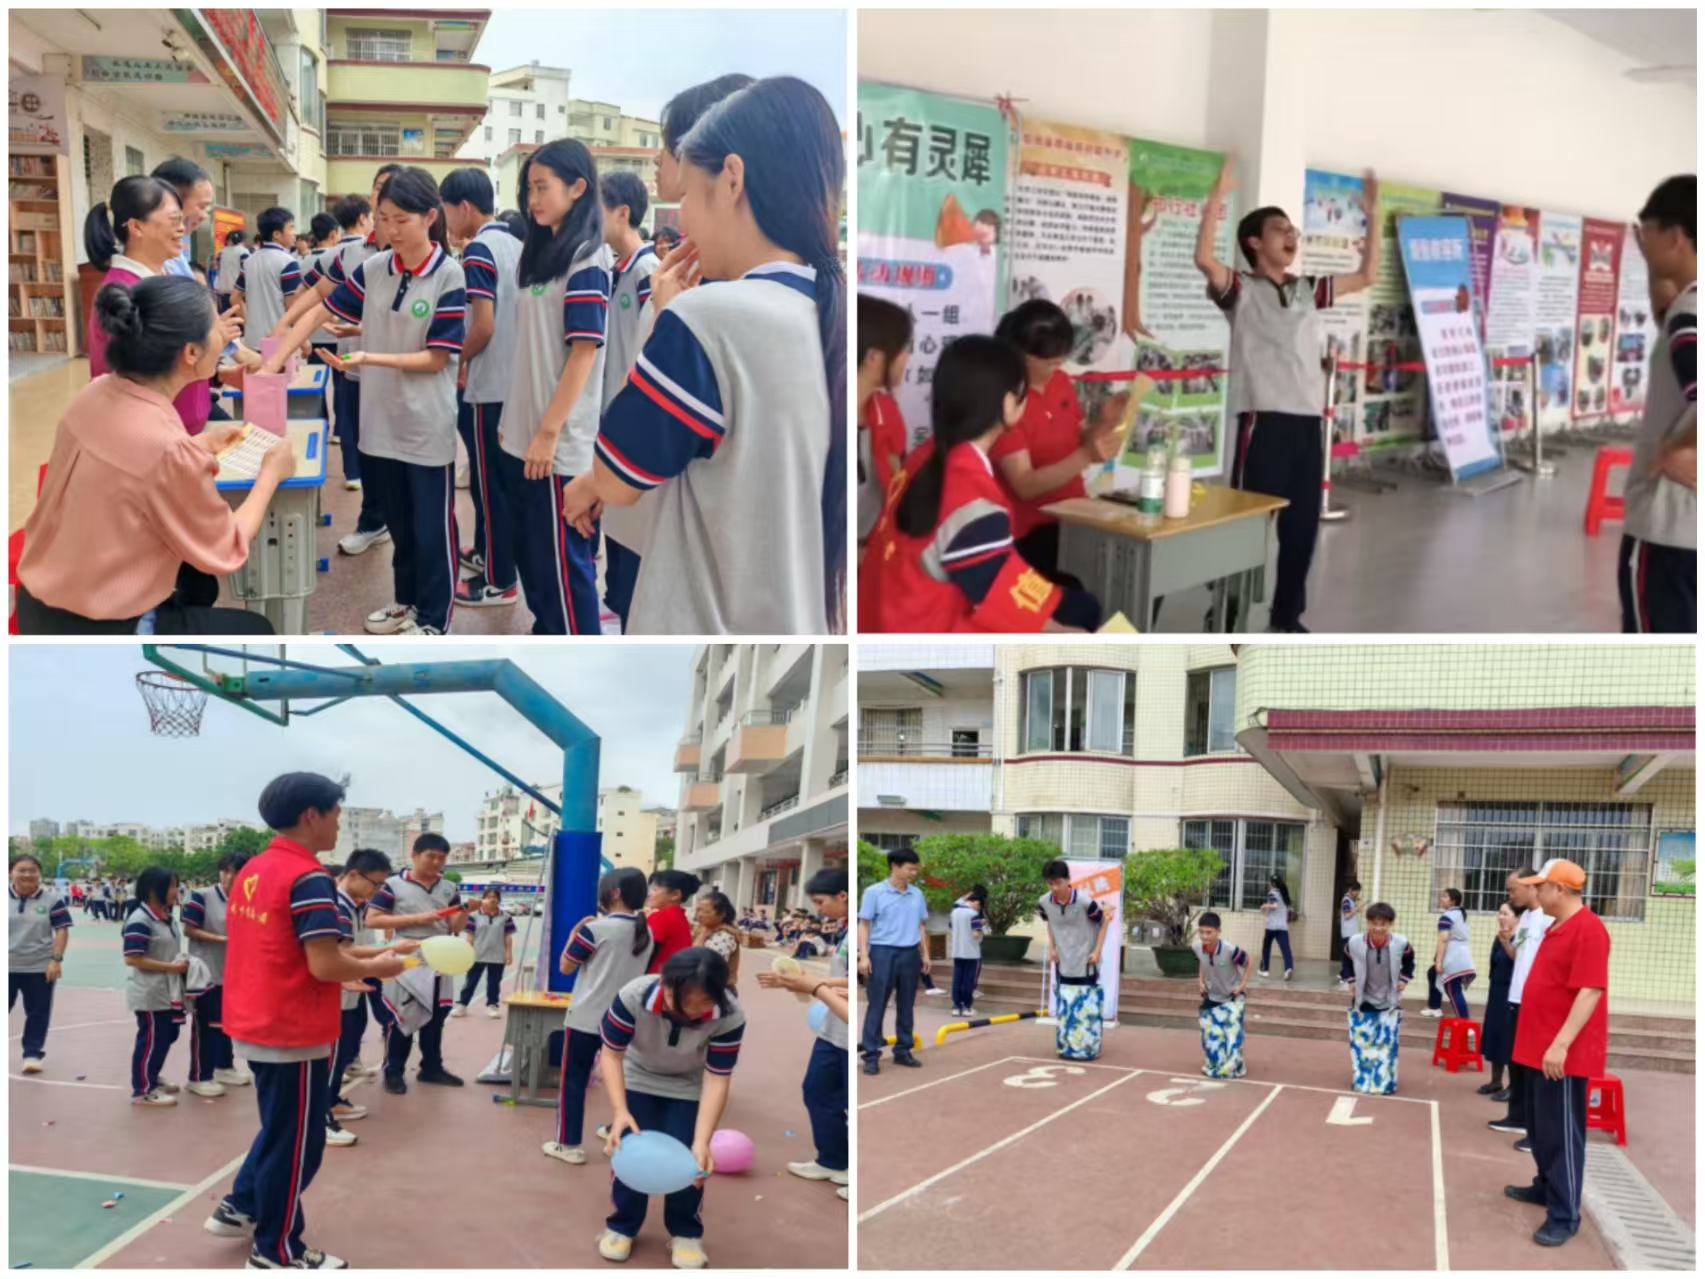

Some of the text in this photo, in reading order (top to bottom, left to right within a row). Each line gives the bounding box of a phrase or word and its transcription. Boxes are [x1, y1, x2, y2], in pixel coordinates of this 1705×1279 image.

[1003, 1065, 1086, 1089] 3
[1146, 1078, 1226, 1106] 2
[1325, 1096, 1374, 1126] 1
